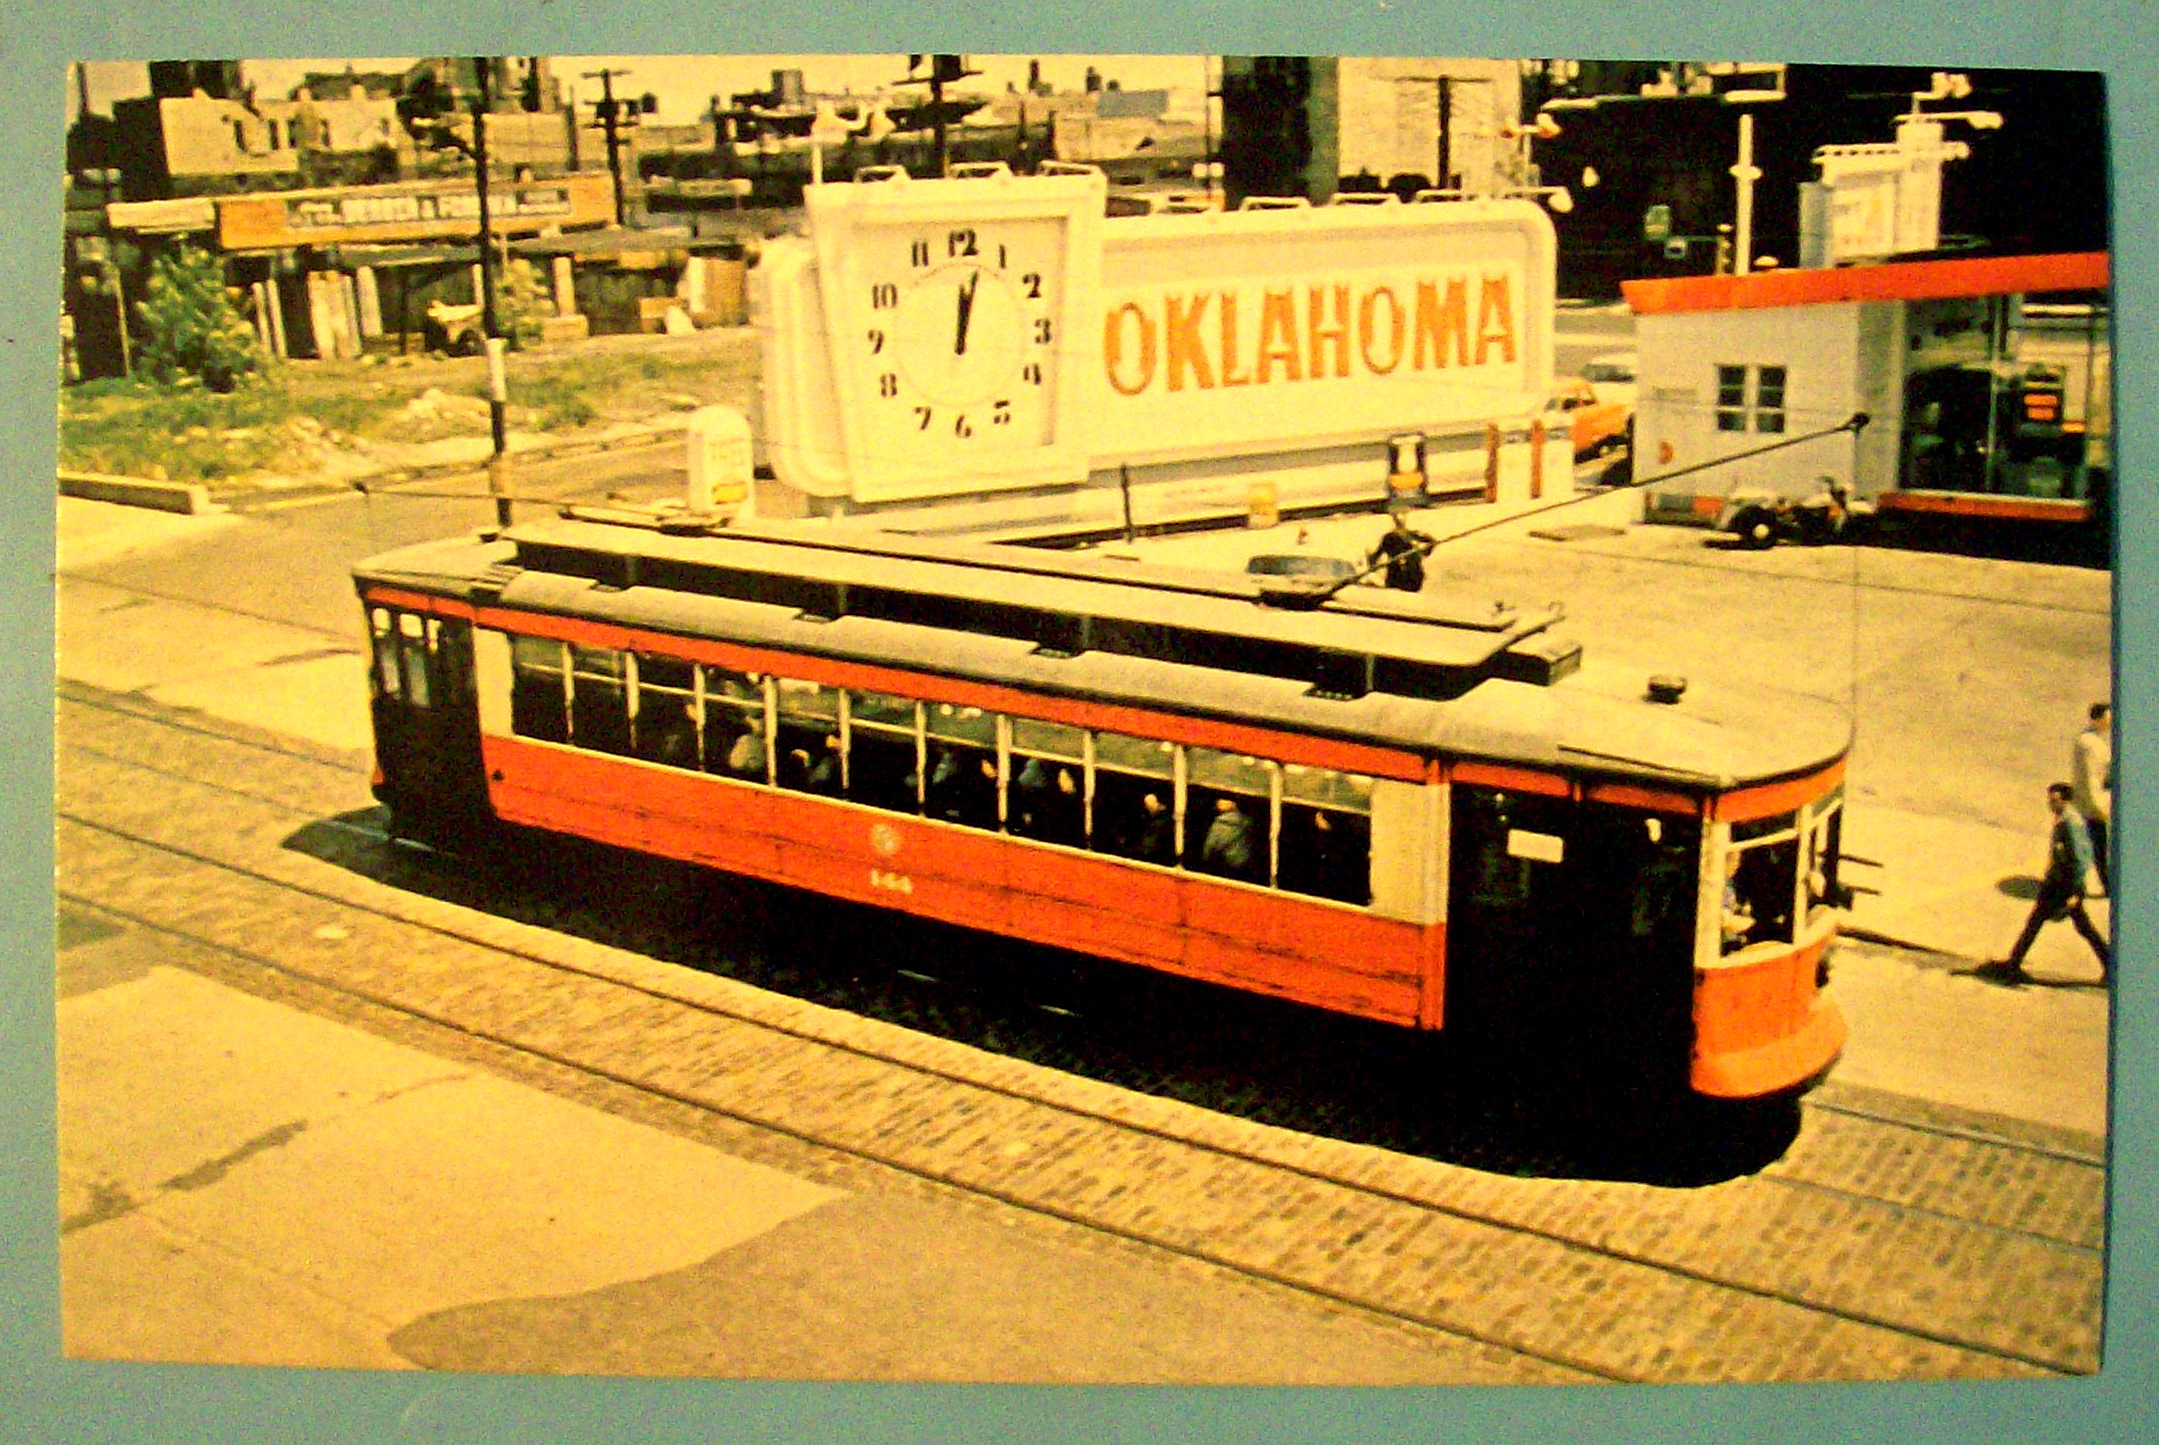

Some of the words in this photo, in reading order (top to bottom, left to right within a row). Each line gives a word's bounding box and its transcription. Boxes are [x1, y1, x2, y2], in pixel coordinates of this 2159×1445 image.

[911, 239, 929, 267] 11
[948, 228, 979, 258] 12
[998, 243, 1007, 269] 1
[872, 283, 898, 310] 10
[1022, 272, 1042, 299] 2
[867, 329, 885, 355] 9
[1034, 317, 1052, 345] 3
[1104, 273, 1517, 396] OKLAHOMA
[879, 373, 898, 398] 8
[1023, 363, 1042, 385] 4
[914, 406, 932, 431] 7
[993, 399, 1012, 425] 5
[954, 414, 972, 439] 6
